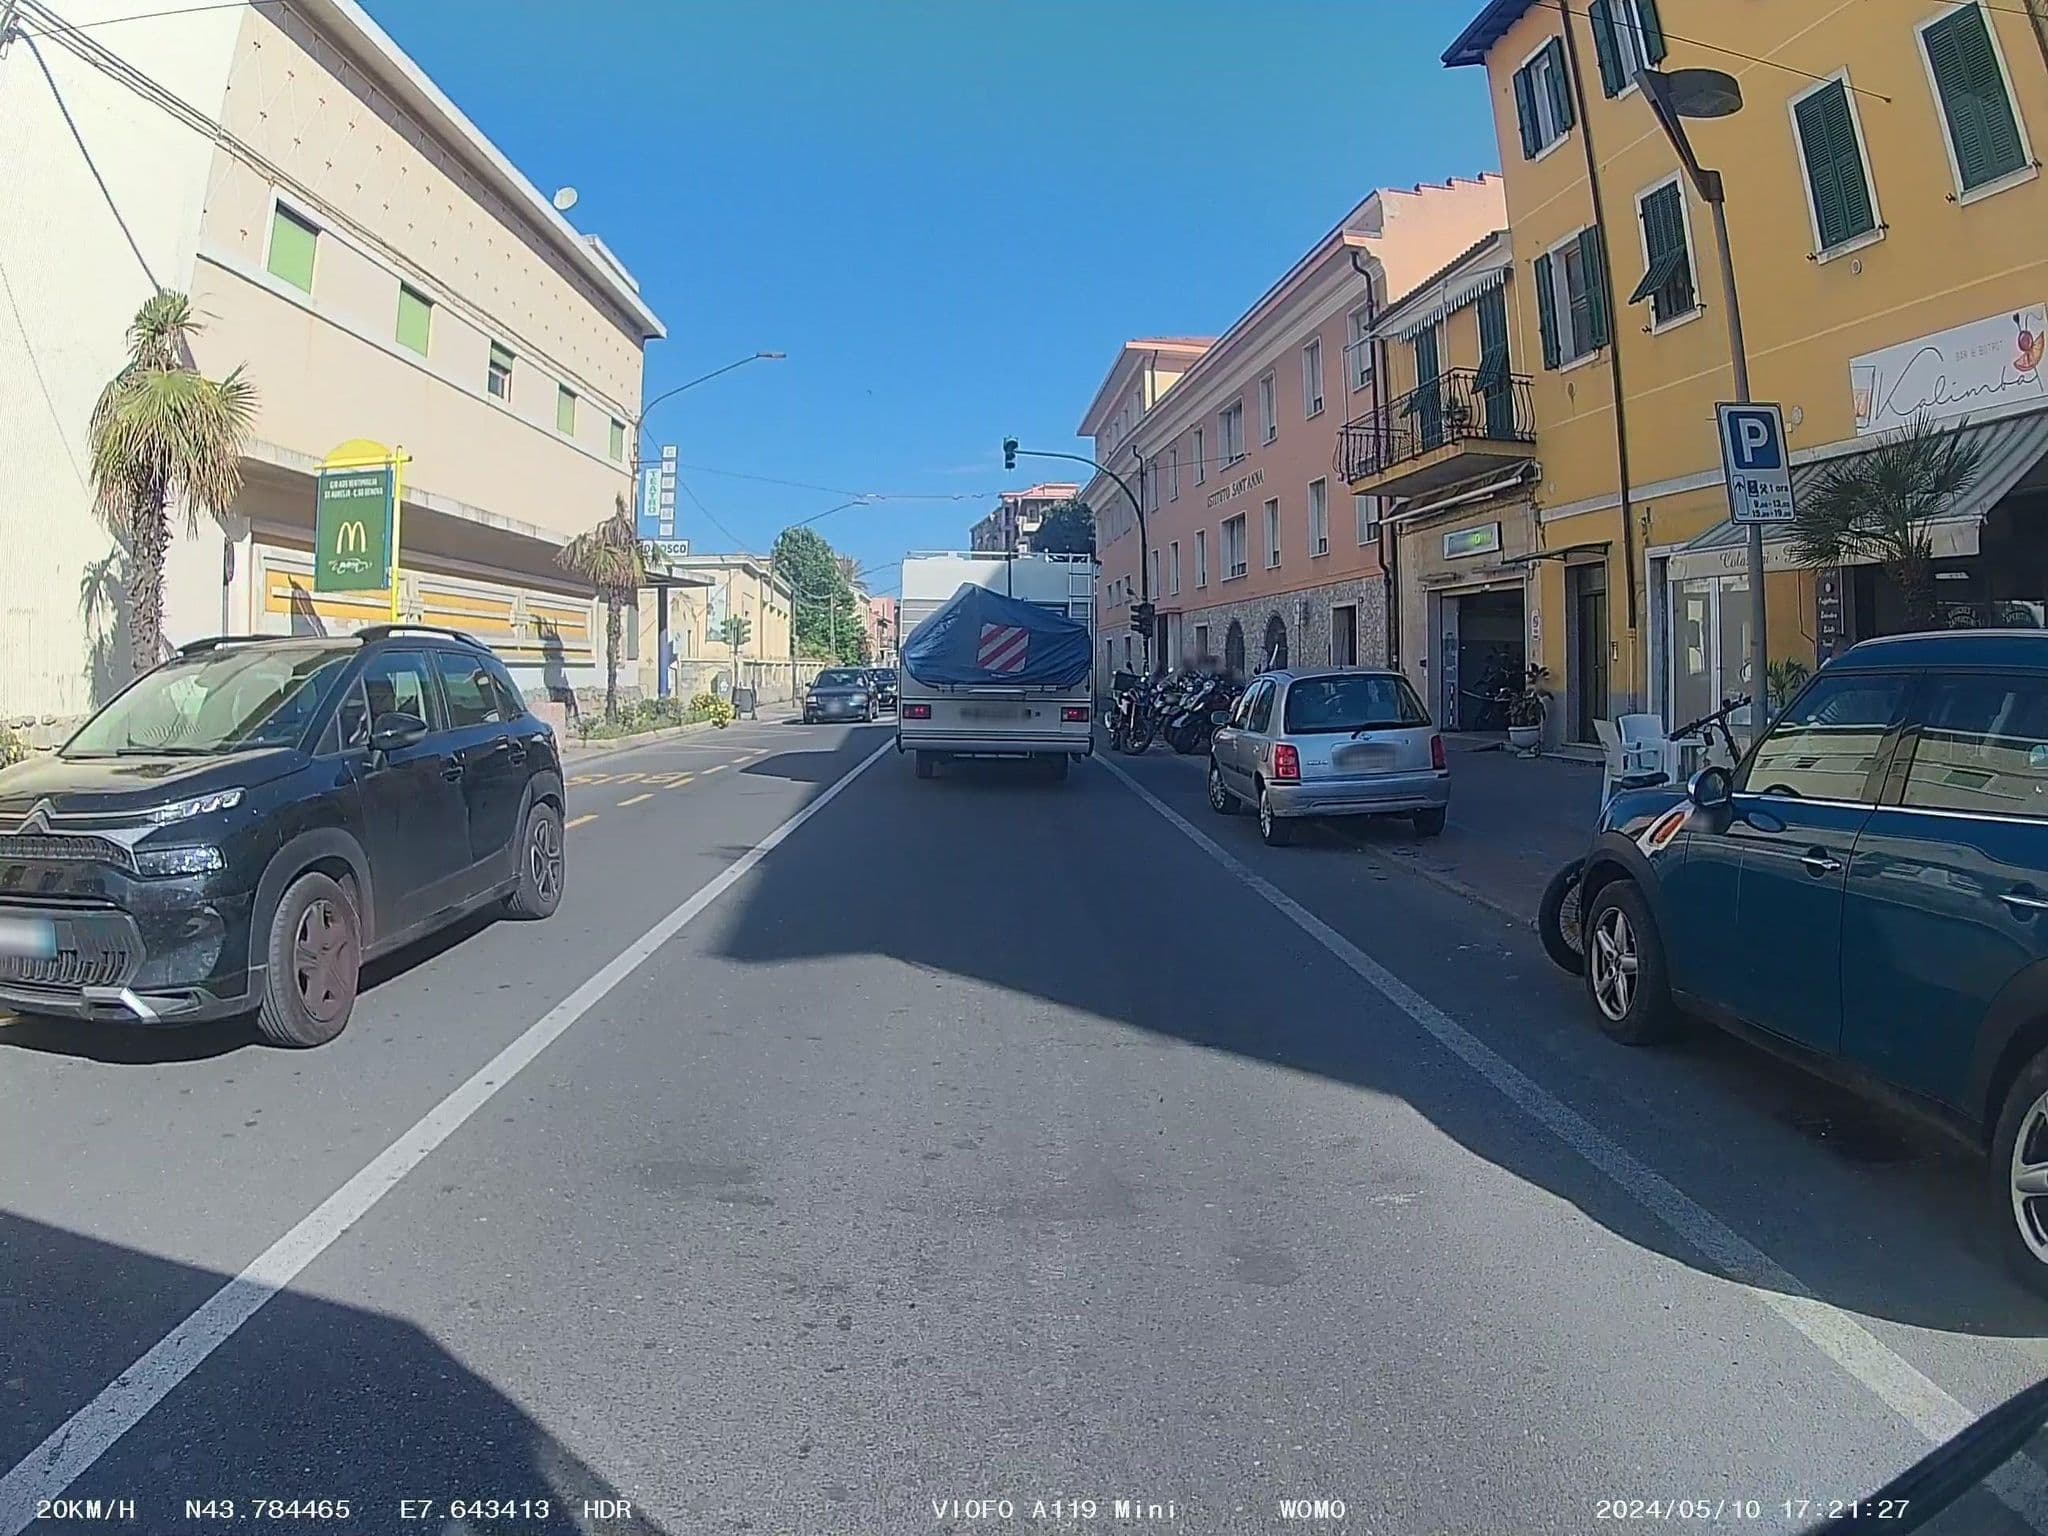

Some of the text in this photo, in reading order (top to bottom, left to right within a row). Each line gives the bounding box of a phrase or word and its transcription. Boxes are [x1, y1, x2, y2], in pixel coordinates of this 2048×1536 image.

[1876, 347, 2038, 420] Kalimba
[1738, 417, 1769, 463] P
[648, 471, 657, 514] TEATRO
[336, 520, 367, 555] M
[655, 543, 687, 554] OSCO
